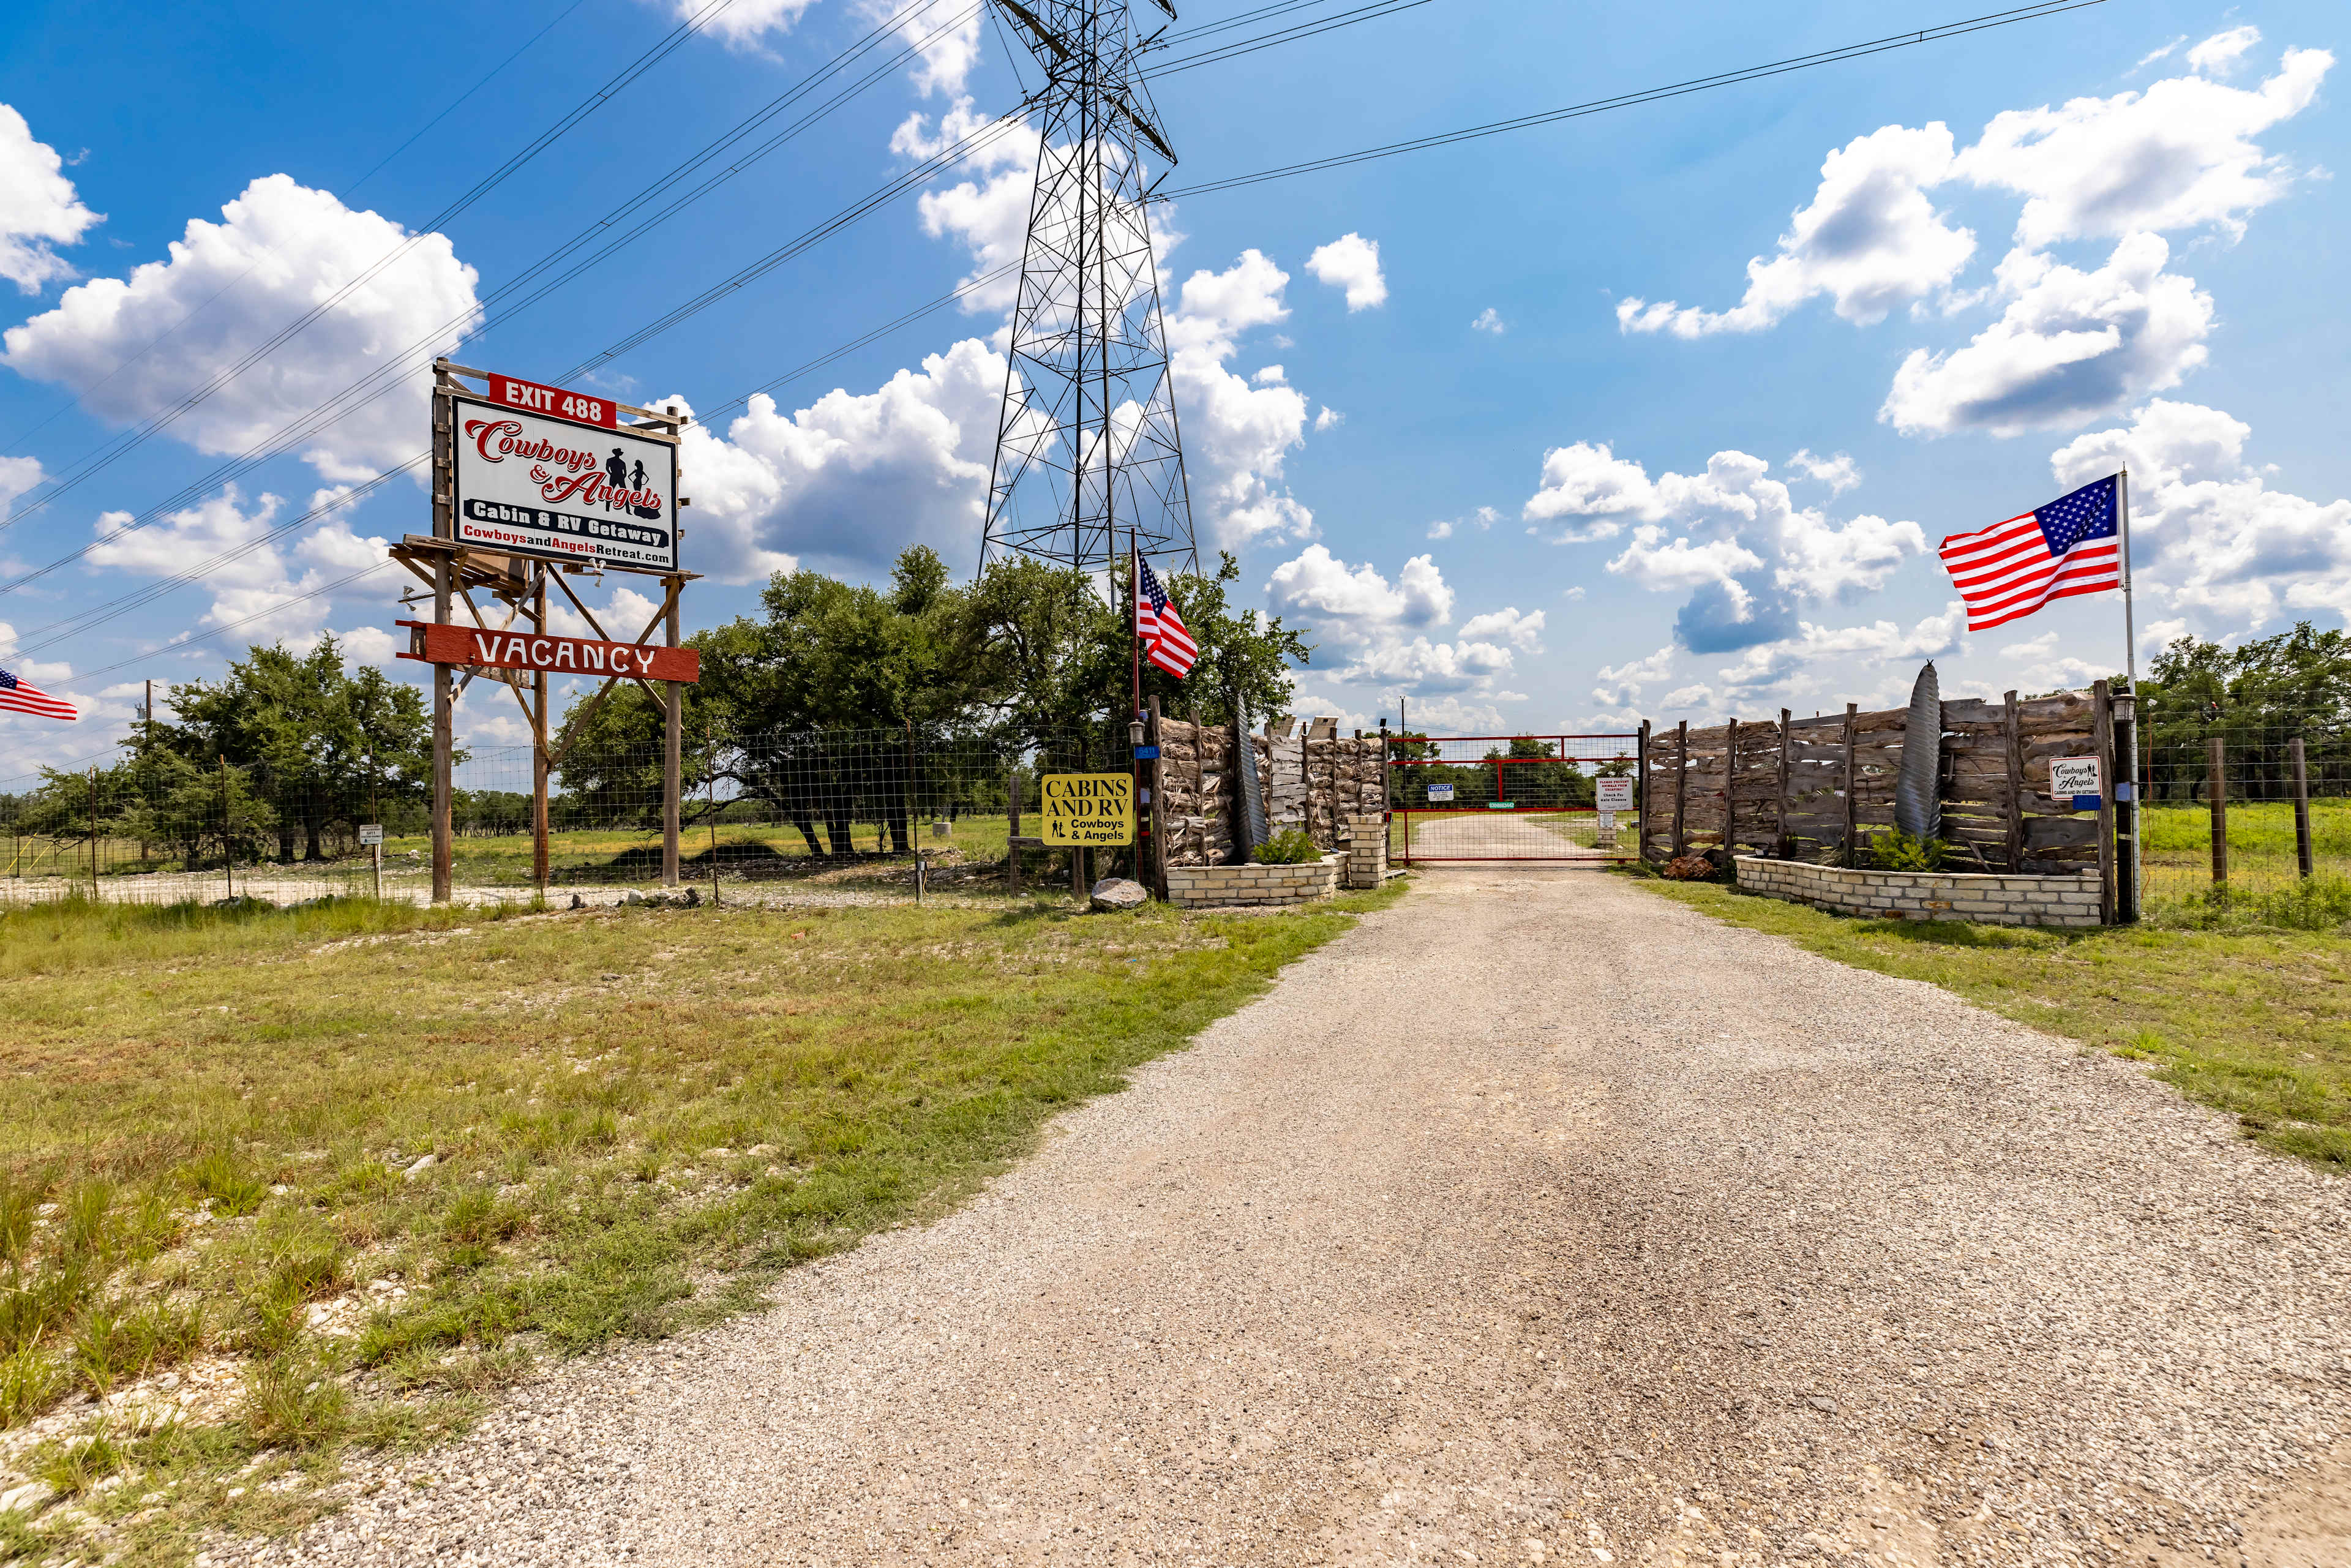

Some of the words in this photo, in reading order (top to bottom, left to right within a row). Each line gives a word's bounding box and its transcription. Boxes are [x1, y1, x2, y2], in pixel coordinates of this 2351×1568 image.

[506, 381, 555, 411] EXIT
[561, 396, 602, 422] 488
[465, 419, 597, 473] Cowboys
[530, 464, 552, 483] &
[541, 471, 662, 509] Angels
[473, 501, 531, 524] Cabin
[538, 512, 550, 527] &
[558, 515, 582, 531] RV
[588, 520, 661, 546] Getaway
[464, 525, 669, 564] CowboysandAngelsRetreat.com
[475, 634, 655, 673] VACANCY
[2053, 763, 2088, 778] Cowboys
[2058, 776, 2094, 790] Angels
[1046, 779, 1127, 798] CABINS
[1046, 799, 1093, 817] AND
[1098, 798, 1128, 816] RV
[1071, 819, 1124, 830] Cowboys
[1071, 830, 1080, 840] &
[1084, 830, 1124, 842] Angels
